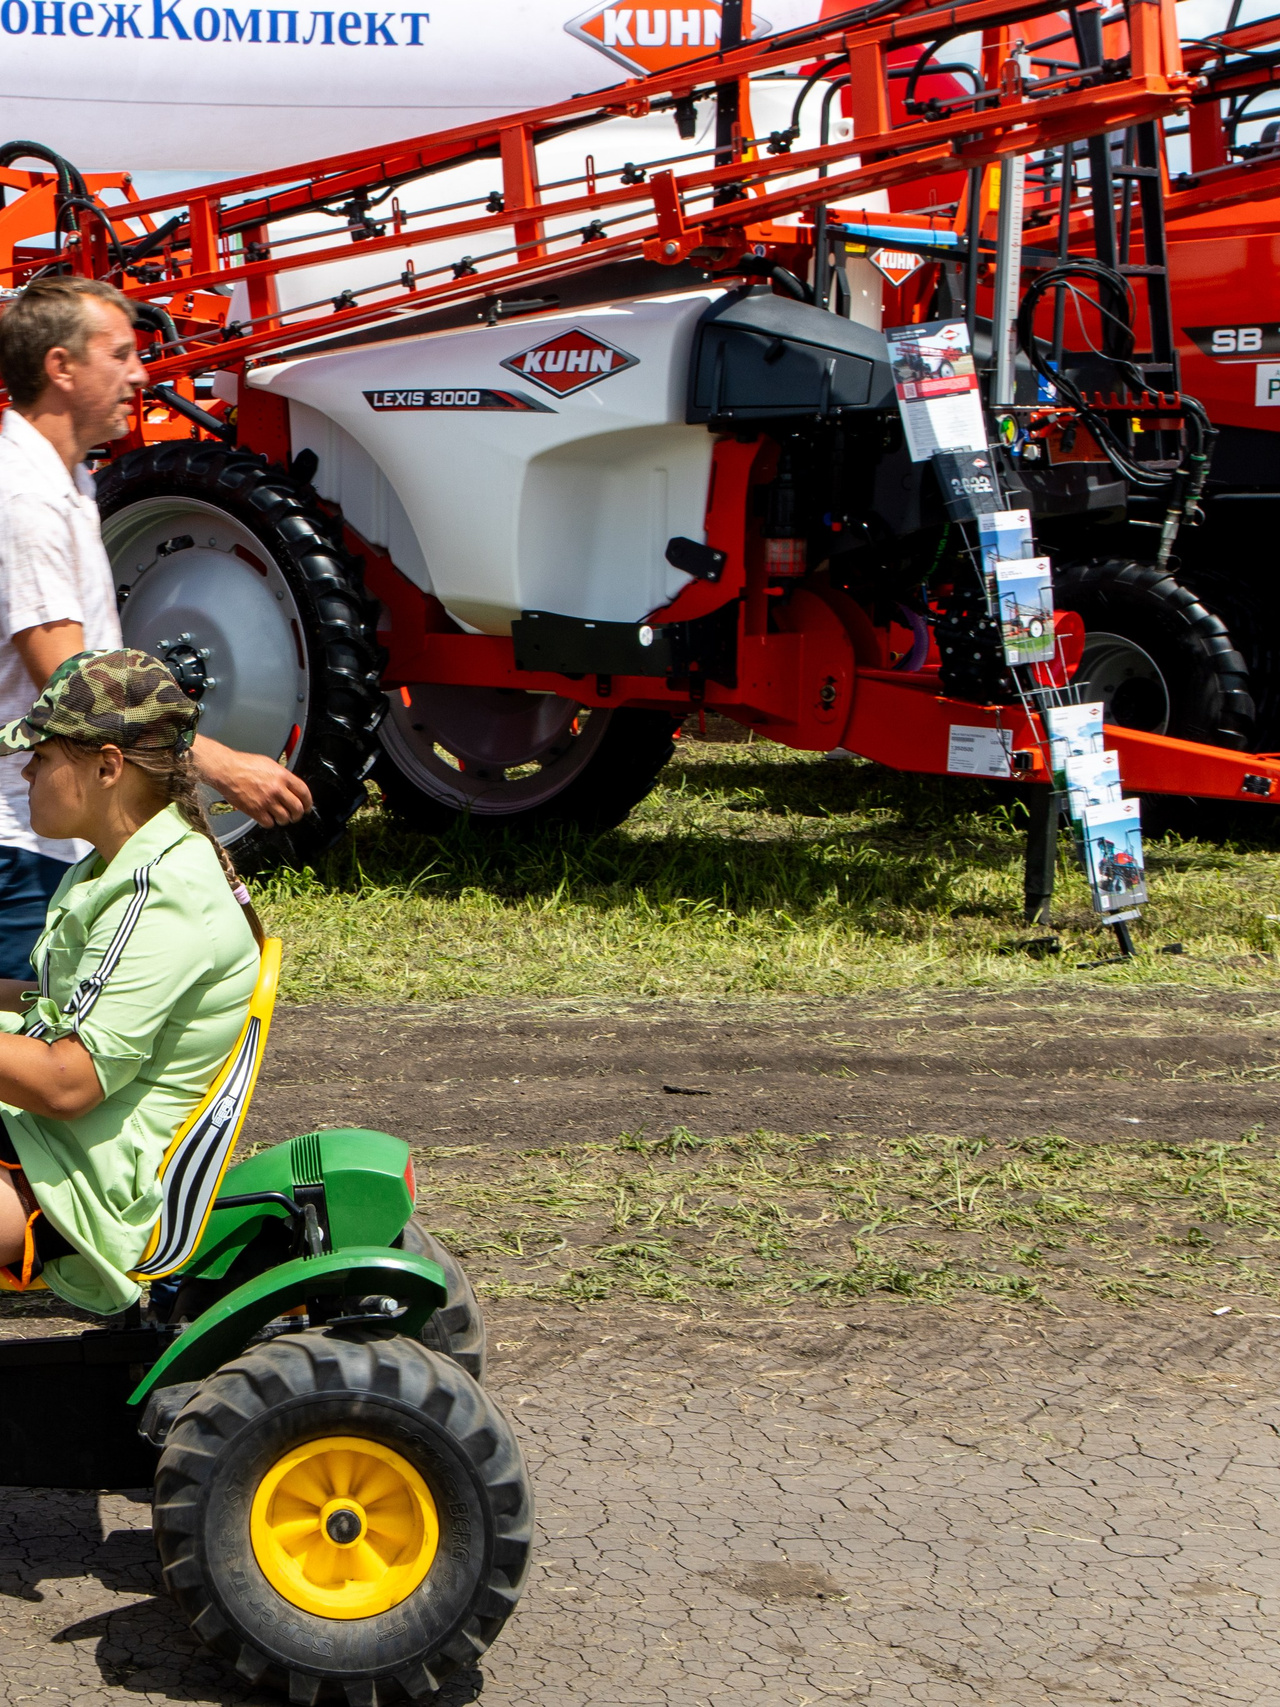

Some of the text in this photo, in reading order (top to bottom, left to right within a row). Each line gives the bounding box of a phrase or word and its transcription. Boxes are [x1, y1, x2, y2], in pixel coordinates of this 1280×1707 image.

[880, 251, 915, 270] KUHN
[1211, 327, 1263, 353] SB
[523, 349, 613, 373] KUHN
[373, 391, 480, 406] LEXIS 3000
[951, 475, 993, 496] 2022
[448, 1501, 471, 1564] BERG
